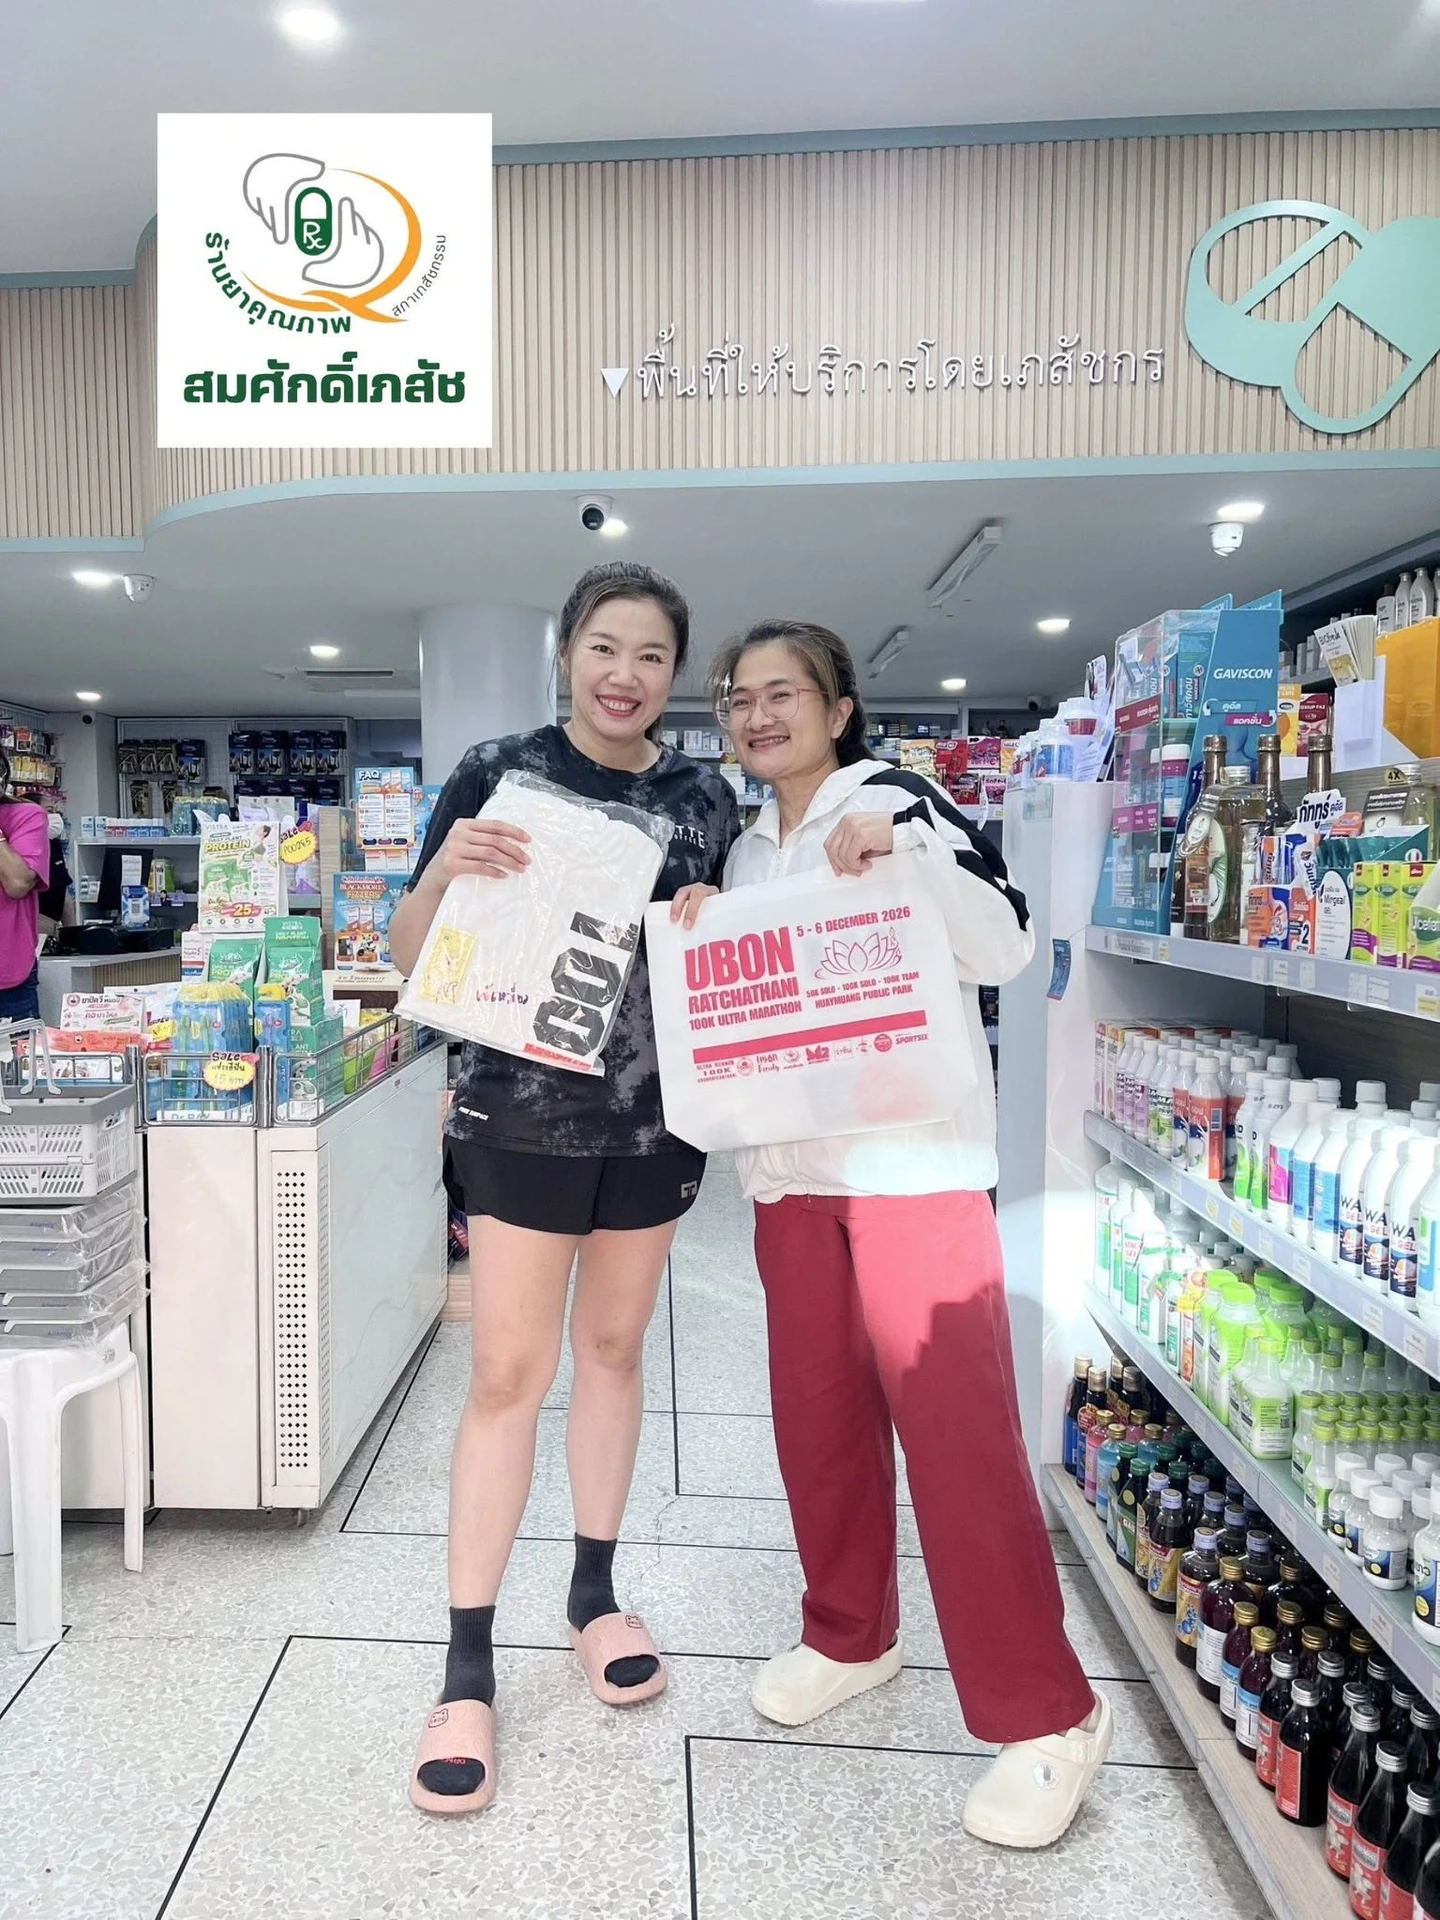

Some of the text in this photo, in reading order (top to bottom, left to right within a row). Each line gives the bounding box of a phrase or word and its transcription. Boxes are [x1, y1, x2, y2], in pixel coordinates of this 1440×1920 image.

[636, 324, 1164, 399] พื้นที่ให้บริการโดยเภสัชกร
[1213, 668, 1273, 680] GAVISCON
[358, 769, 380, 781] FAQ
[1387, 772, 1401, 780] 4X
[205, 840, 251, 853] PROTEIN
[233, 904, 252, 915] 25
[796, 925, 805, 937] 5
[815, 922, 823, 934] 6
[825, 912, 879, 932] DECEMBER
[881, 906, 911, 922] 2026
[685, 926, 795, 991] UBON
[688, 976, 800, 1015] RATCHATHANI
[815, 984, 914, 1009] HUAYMUANG PUBLIC PARK
[689, 1000, 803, 1031] 100K ULTRA MARATHON
